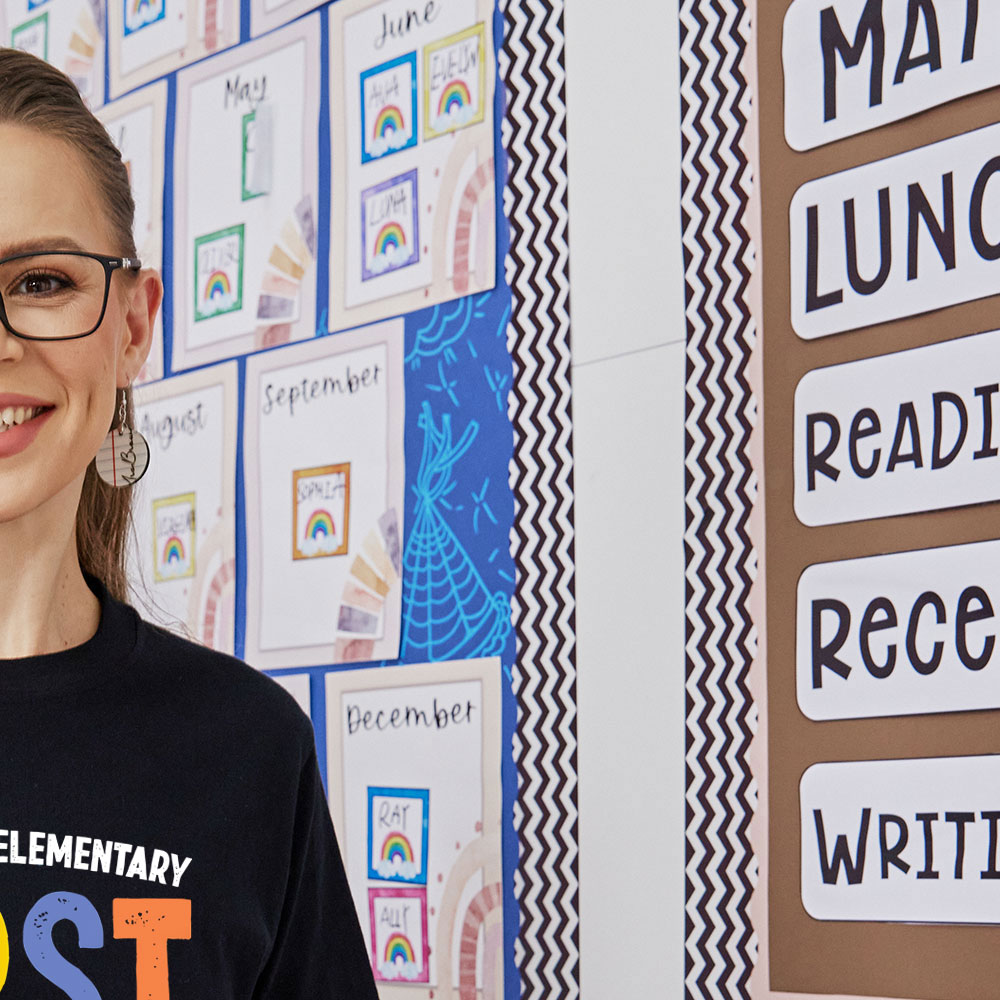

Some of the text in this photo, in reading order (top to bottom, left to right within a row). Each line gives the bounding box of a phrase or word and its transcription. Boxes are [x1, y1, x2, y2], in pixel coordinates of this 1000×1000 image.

[374, 0, 439, 49] June
[224, 75, 268, 110] May
[263, 365, 382, 416] September
[142, 403, 206, 449] August
[346, 697, 477, 736] December
